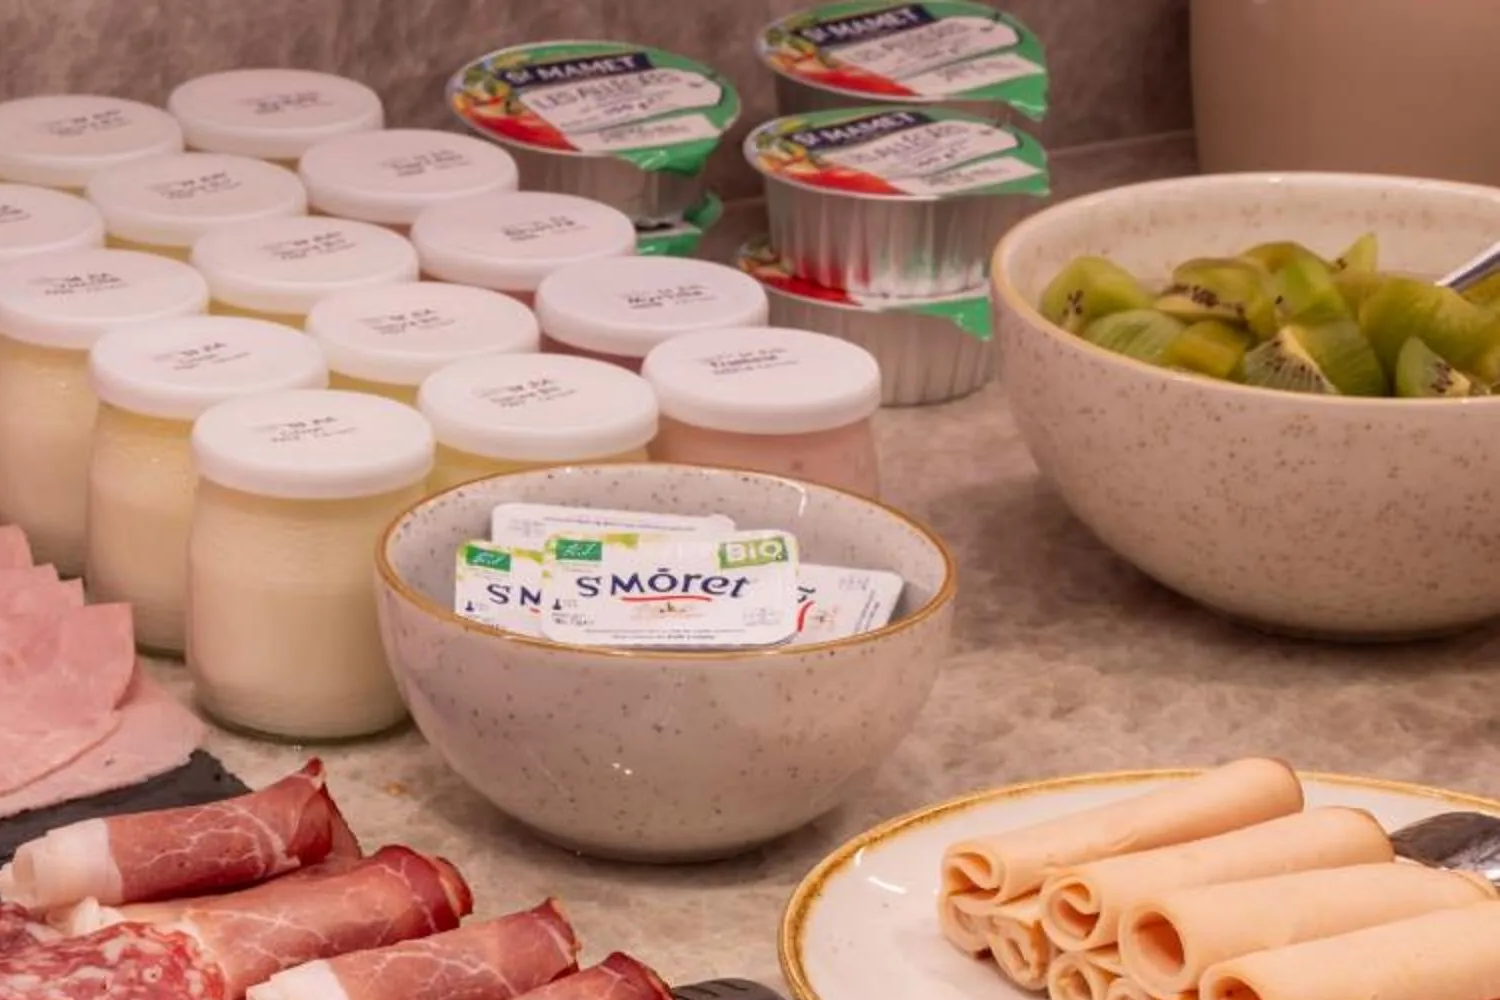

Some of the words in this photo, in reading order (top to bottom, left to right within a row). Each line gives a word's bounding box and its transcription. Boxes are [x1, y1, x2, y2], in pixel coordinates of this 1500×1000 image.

[828, 8, 919, 38] MAMET
[537, 56, 636, 80] MAMET
[820, 112, 915, 141] MAMET
[726, 538, 784, 563] BIO
